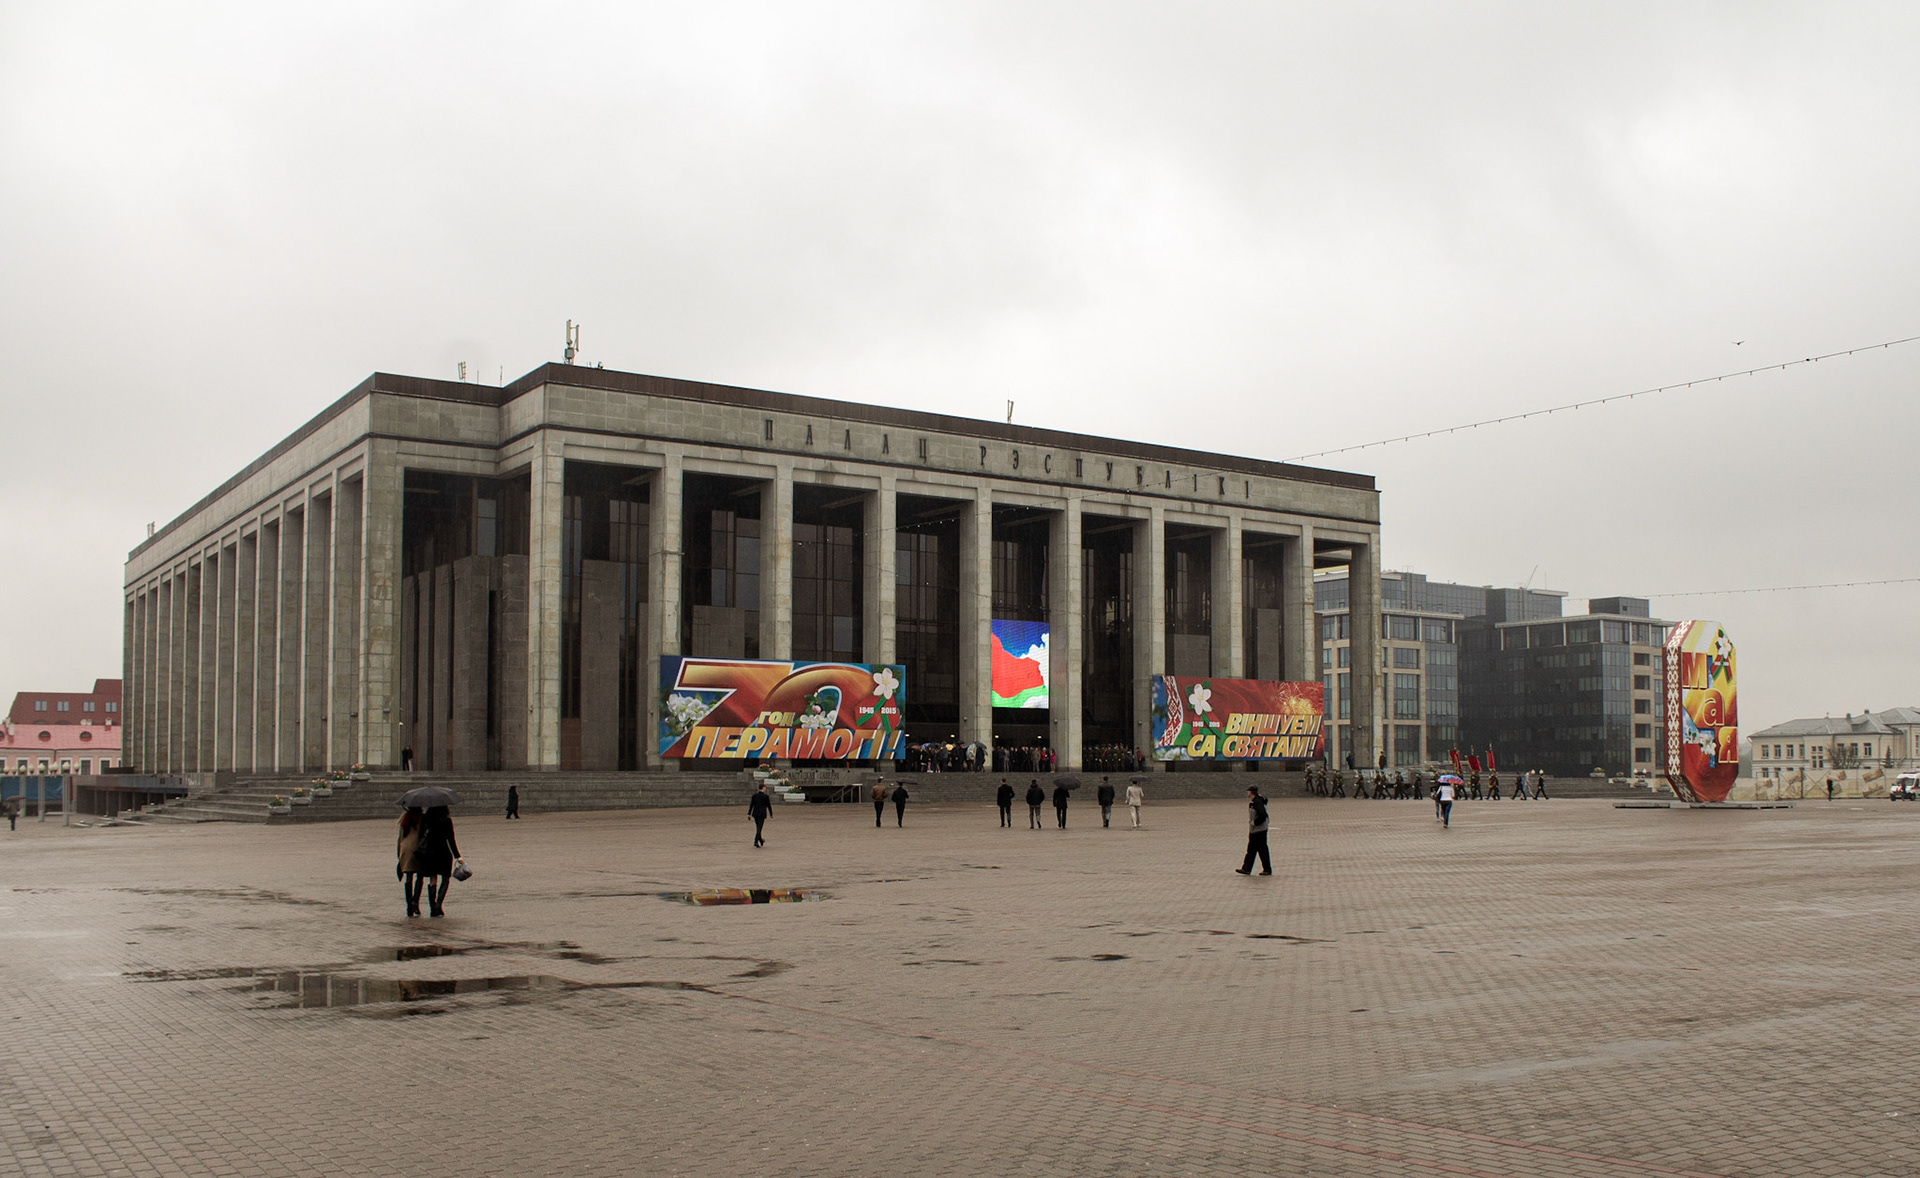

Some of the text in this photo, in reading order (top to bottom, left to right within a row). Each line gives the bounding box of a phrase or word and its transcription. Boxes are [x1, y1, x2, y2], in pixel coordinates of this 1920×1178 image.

[765, 418, 1250, 499] ПАЛАЦ РЭСПУБЛІКІ
[664, 657, 876, 745] 70
[859, 706, 897, 715] 1945 2015
[1225, 712, 1322, 735] ВІНШУЕМ
[683, 726, 904, 759] ПЕРАМОГІ!
[1187, 734, 1318, 758] СА СВЯТАМ!
